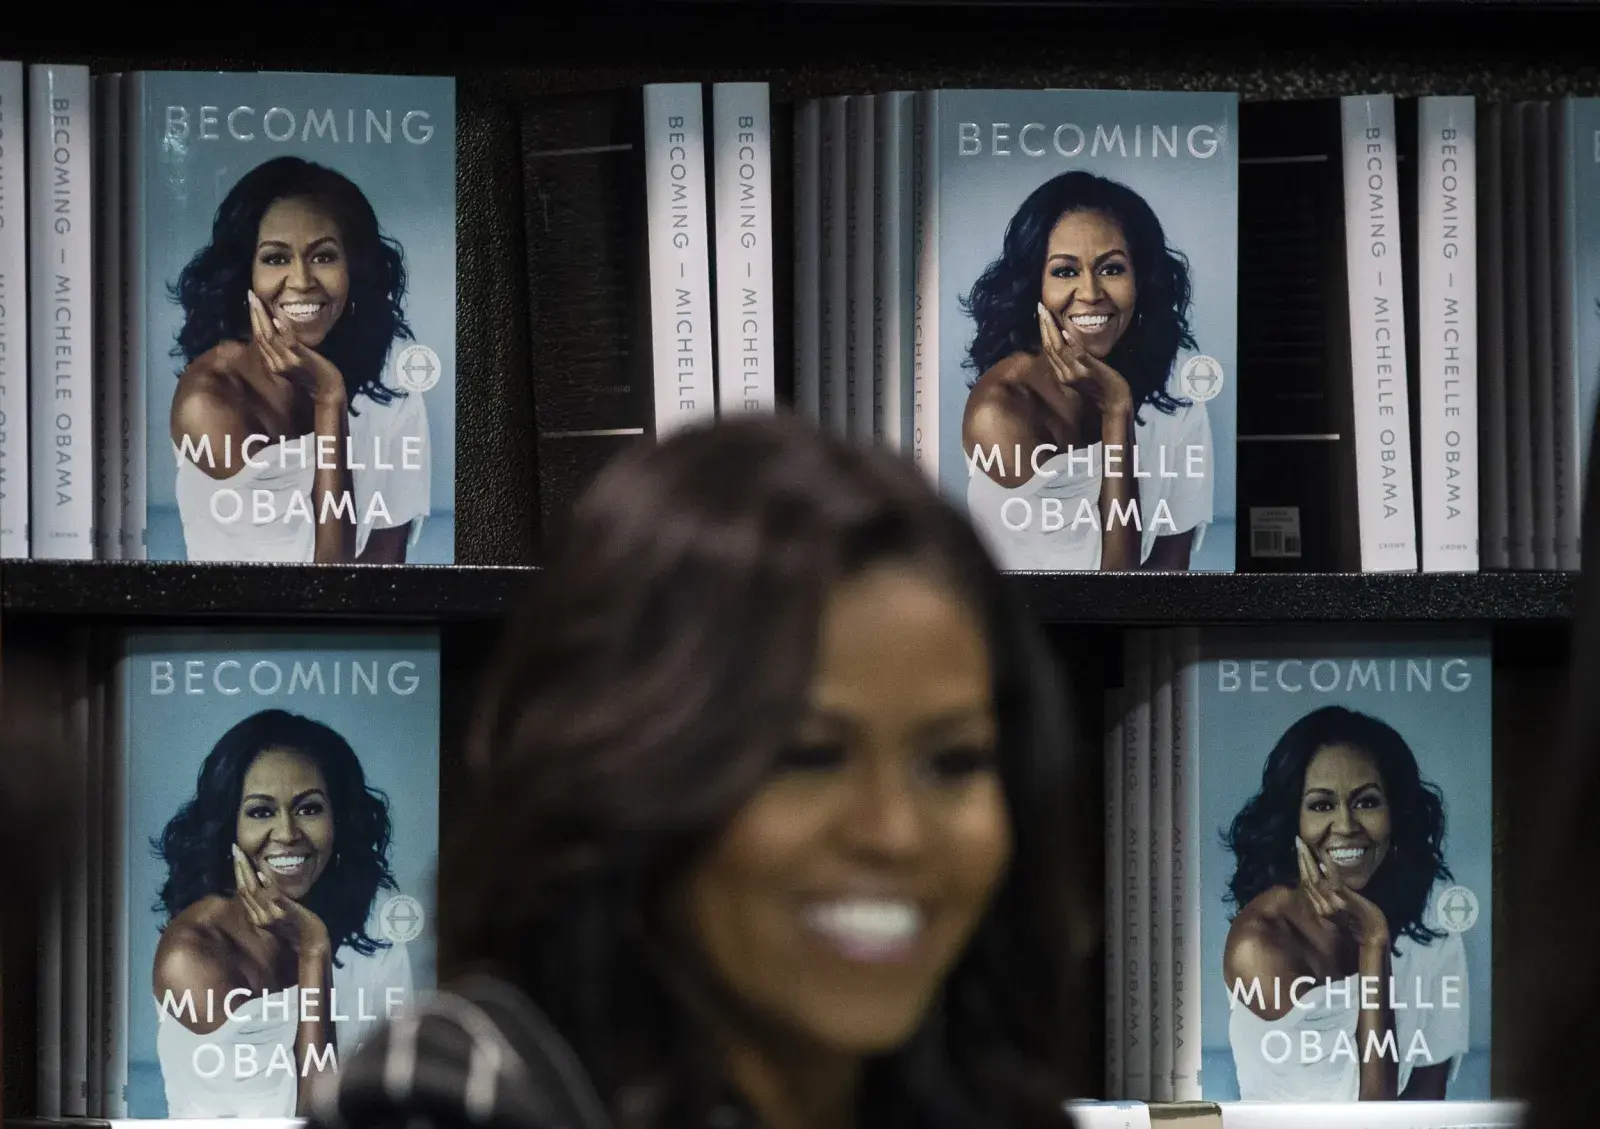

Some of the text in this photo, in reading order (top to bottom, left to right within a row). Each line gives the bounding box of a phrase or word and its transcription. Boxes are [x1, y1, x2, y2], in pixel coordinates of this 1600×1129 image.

[52, 98, 71, 235] BECOMING
[165, 104, 436, 145] BECOMING
[957, 121, 1219, 160] BECOMING
[667, 115, 690, 250] BECOMING
[737, 115, 757, 250] BECOMING
[1365, 127, 1387, 258] BECOMING
[1440, 128, 1459, 260] BECOMING
[55, 274, 73, 400] MICHELLE
[674, 288, 695, 411] MICHELLE
[741, 288, 760, 411] MICHELLE
[915, 295, 923, 413] MICHELLE
[1373, 296, 1395, 417] MICHELLE
[1443, 297, 1460, 417] MICHELLE
[55, 413, 73, 507] OBAMA
[176, 433, 422, 470] MICHELLE
[967, 443, 1206, 479] MICHELLE
[1379, 429, 1399, 521] OBAMA
[1445, 430, 1461, 521] OBAMA
[209, 488, 393, 525] OBAMA
[999, 497, 1177, 533] OBAMA
[149, 659, 421, 696] BECOMING
[1218, 657, 1473, 692] BECOMING
[158, 987, 405, 1024] MICHELLE
[1129, 959, 1139, 1047] OBAMA
[1174, 960, 1184, 1048] OBAMA
[1229, 975, 1461, 1011] MICHELLE
[191, 1042, 352, 1079] OBAM
[1260, 1029, 1434, 1064] OBAMA
